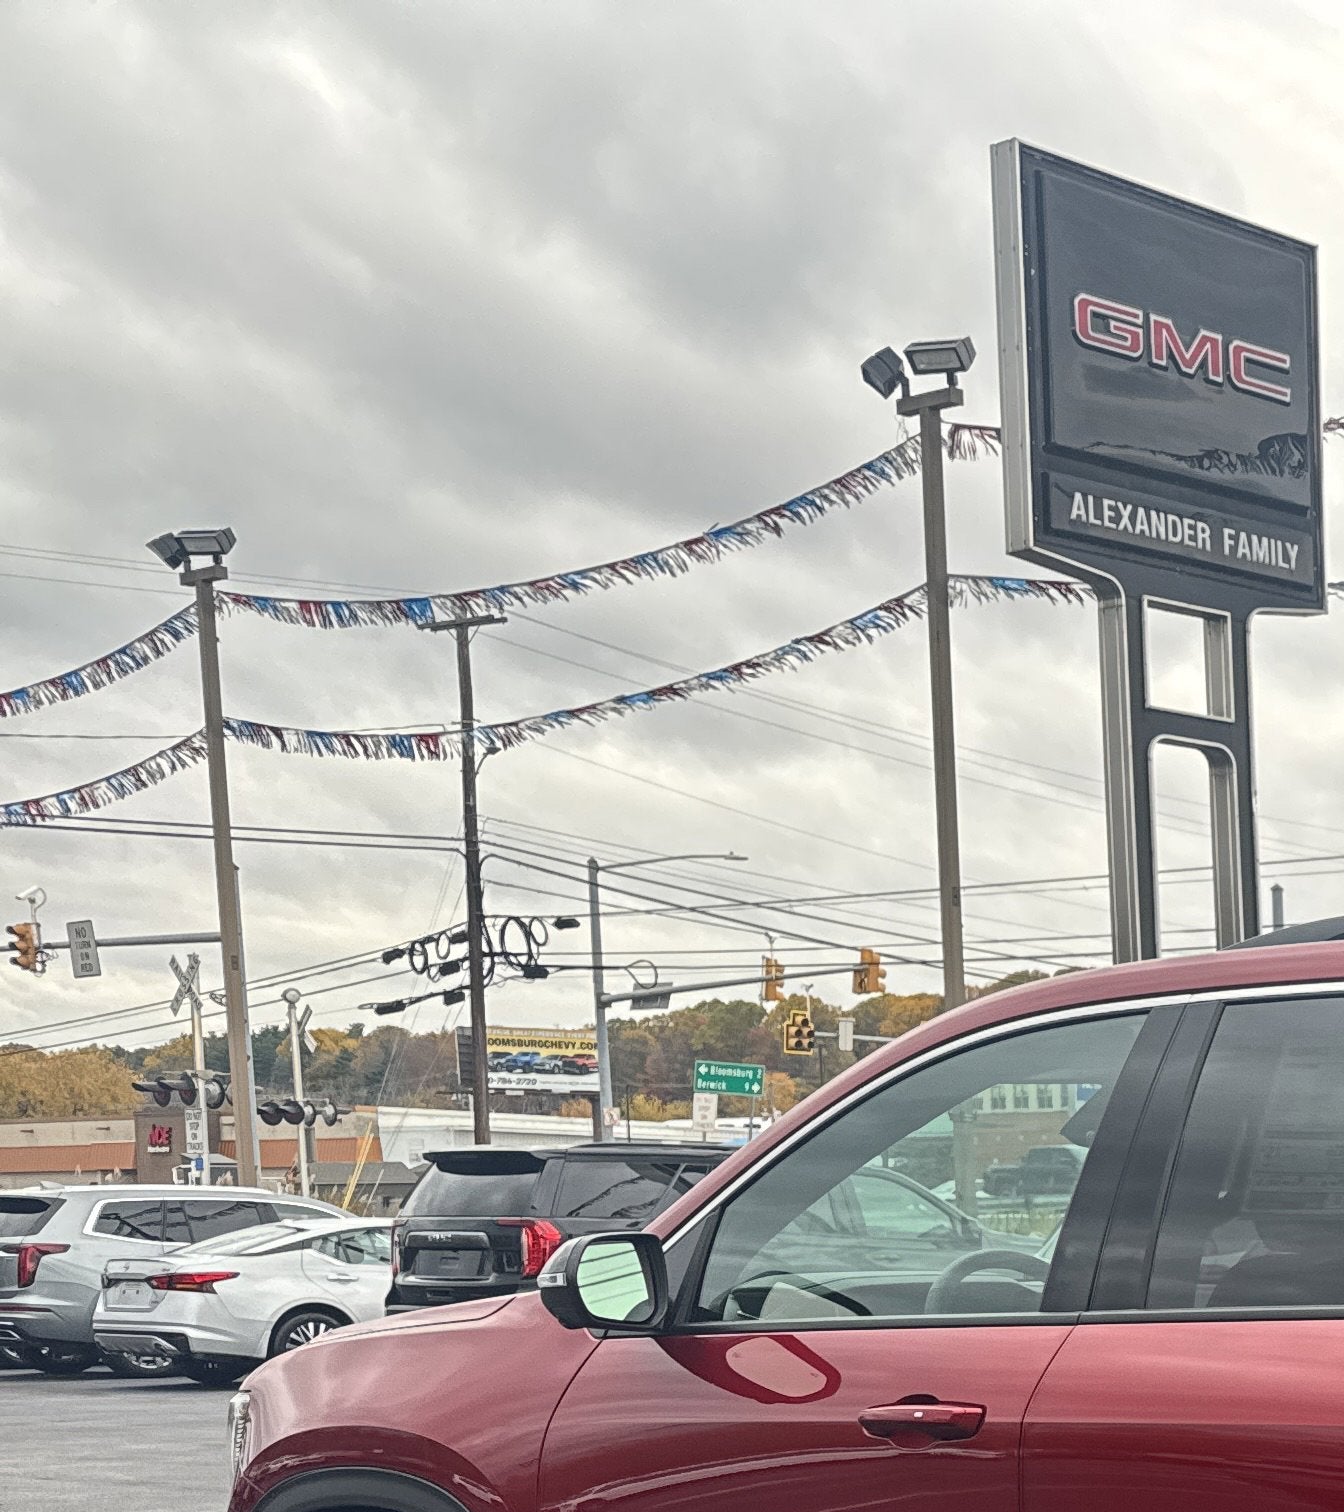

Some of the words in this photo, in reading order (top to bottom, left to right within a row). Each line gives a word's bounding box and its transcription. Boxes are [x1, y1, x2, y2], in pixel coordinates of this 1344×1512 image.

[1072, 292, 1291, 404] GMC
[1070, 491, 1212, 552] ALEXANDER
[1222, 528, 1299, 571] FAMILY
[74, 926, 87, 938] NO
[74, 940, 92, 949] TURN
[80, 951, 90, 961] ON
[80, 962, 94, 972] RED
[487, 1037, 598, 1051] OOMSBURGCHEVY.CO
[710, 1065, 753, 1080] Bloomsburg
[756, 1068, 762, 1079] 2
[697, 1078, 727, 1090] Berwick
[744, 1081, 750, 1092] 9
[189, 1121, 199, 1131] STOP
[148, 1124, 172, 1147] ACE
